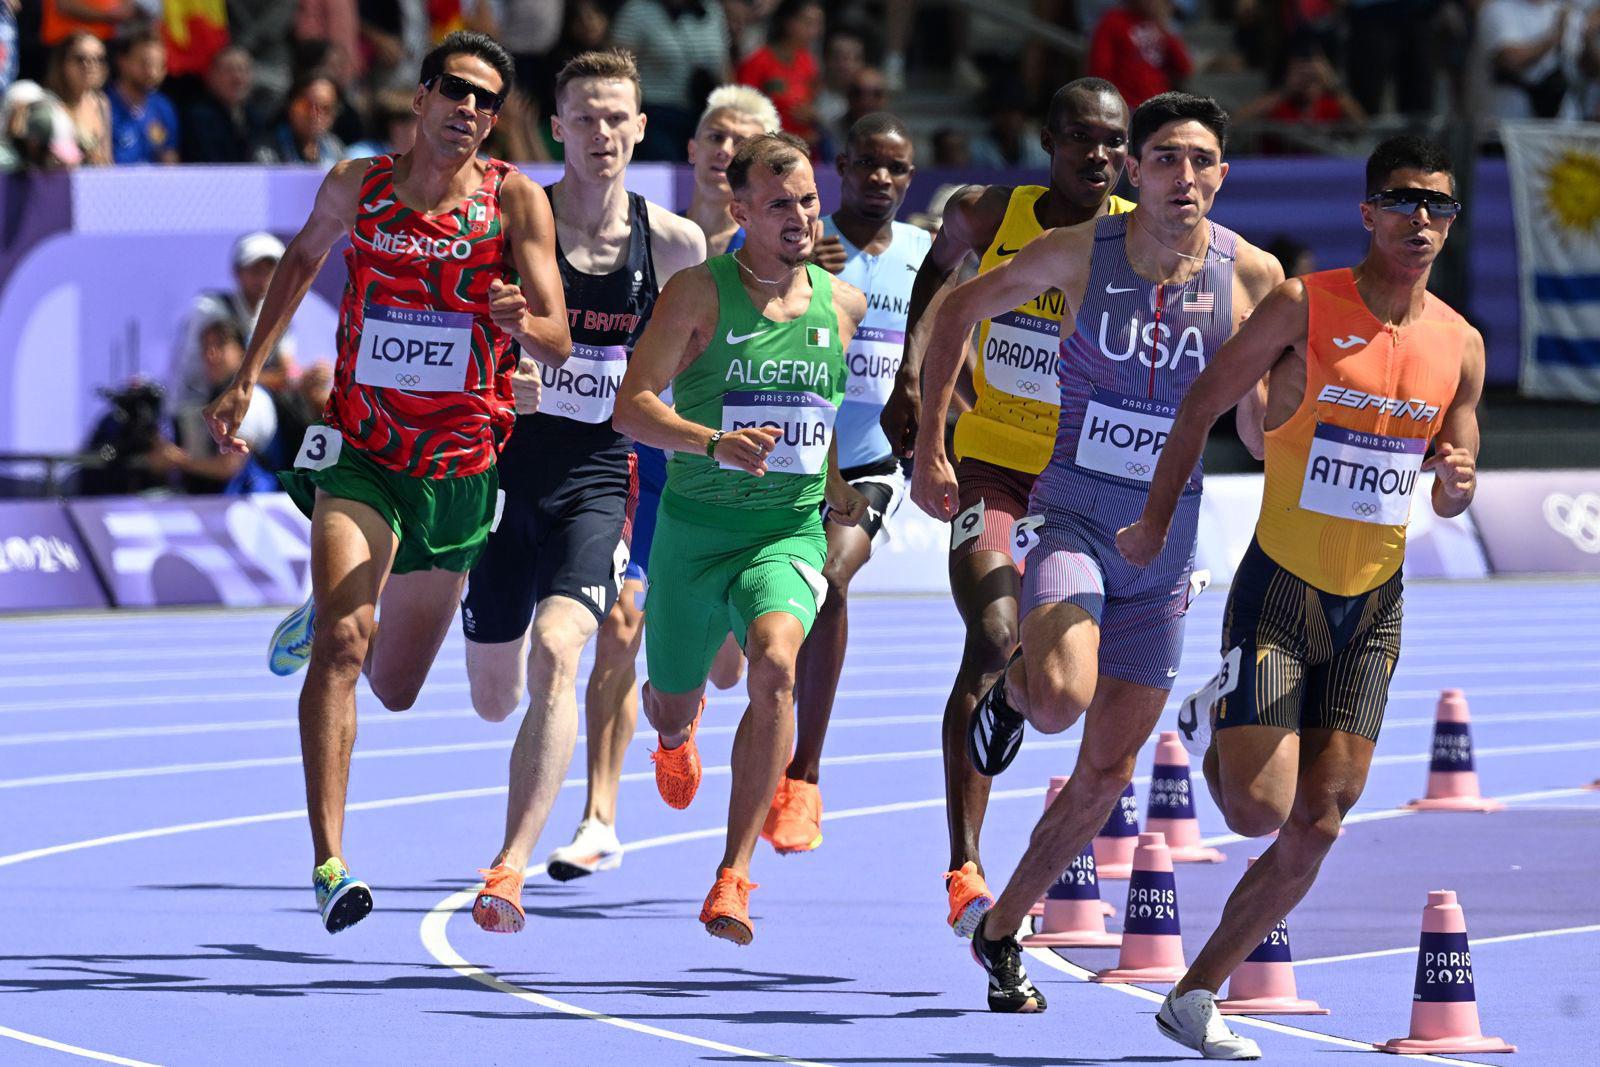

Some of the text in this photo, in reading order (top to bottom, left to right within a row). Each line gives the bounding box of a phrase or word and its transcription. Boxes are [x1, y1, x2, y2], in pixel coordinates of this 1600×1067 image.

[372, 230, 472, 260] MÉXICO
[386, 310, 443, 324] PARIS 2024
[1014, 316, 1042, 329] PARIS
[371, 334, 455, 367] LOPEZ
[1099, 311, 1206, 373] USA
[580, 348, 605, 358] 2024
[725, 358, 828, 387] ALGERIA
[754, 394, 812, 404] PARIS 2024
[1122, 399, 1153, 411] PARIS
[1317, 384, 1441, 423] ESPAÑA
[1088, 416, 1169, 456] HOPP
[1348, 433, 1407, 450] PARIS 2024
[307, 433, 326, 462] 3
[1310, 455, 1417, 496] ATTAOUI
[961, 513, 980, 534] 9
[1015, 522, 1030, 549] 5
[1130, 888, 1174, 904] PARIS
[1130, 904, 1174, 919] 2024
[1263, 931, 1288, 946] 24
[1425, 952, 1471, 967] PARIS
[1426, 969, 1473, 984] 2024
